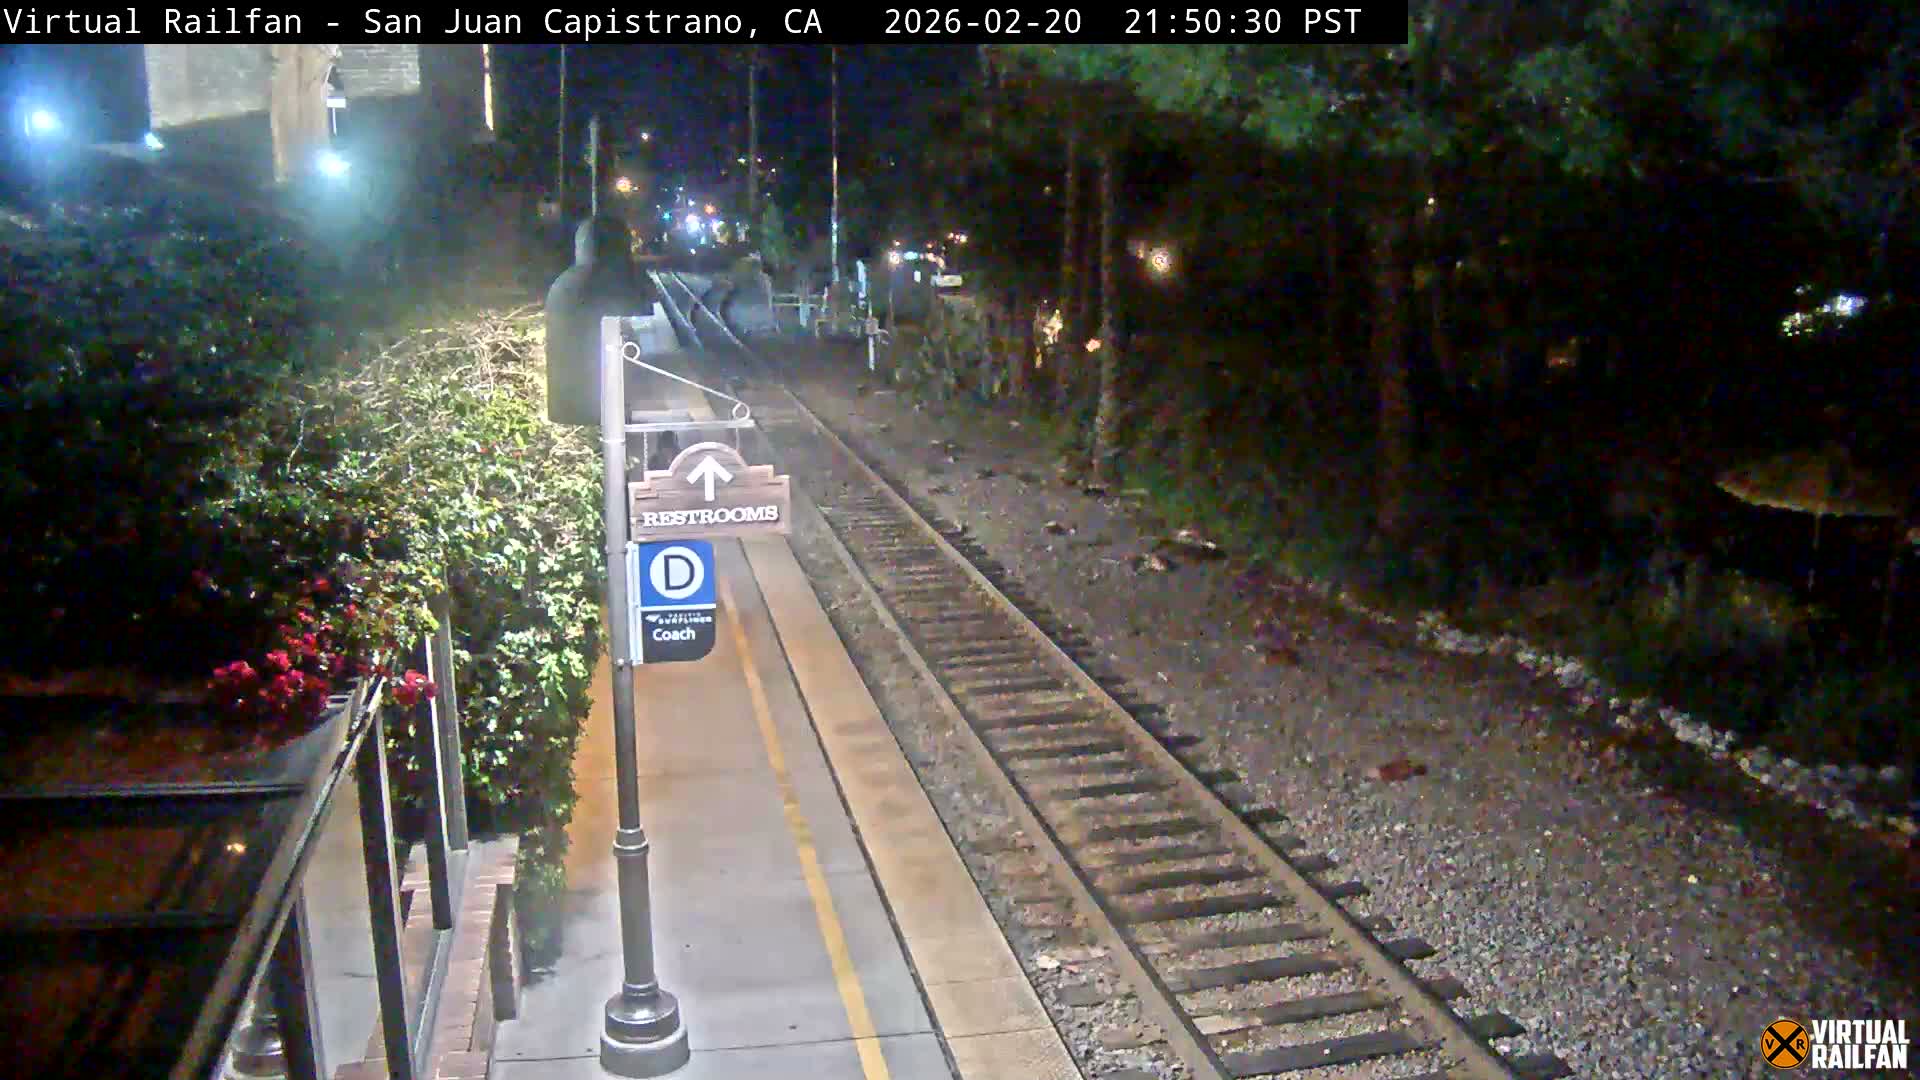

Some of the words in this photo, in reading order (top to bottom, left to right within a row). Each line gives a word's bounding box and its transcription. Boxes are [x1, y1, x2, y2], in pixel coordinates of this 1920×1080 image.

[641, 505, 779, 527] RESTROOMS
[663, 554, 696, 591] D
[652, 626, 696, 641] Coach
